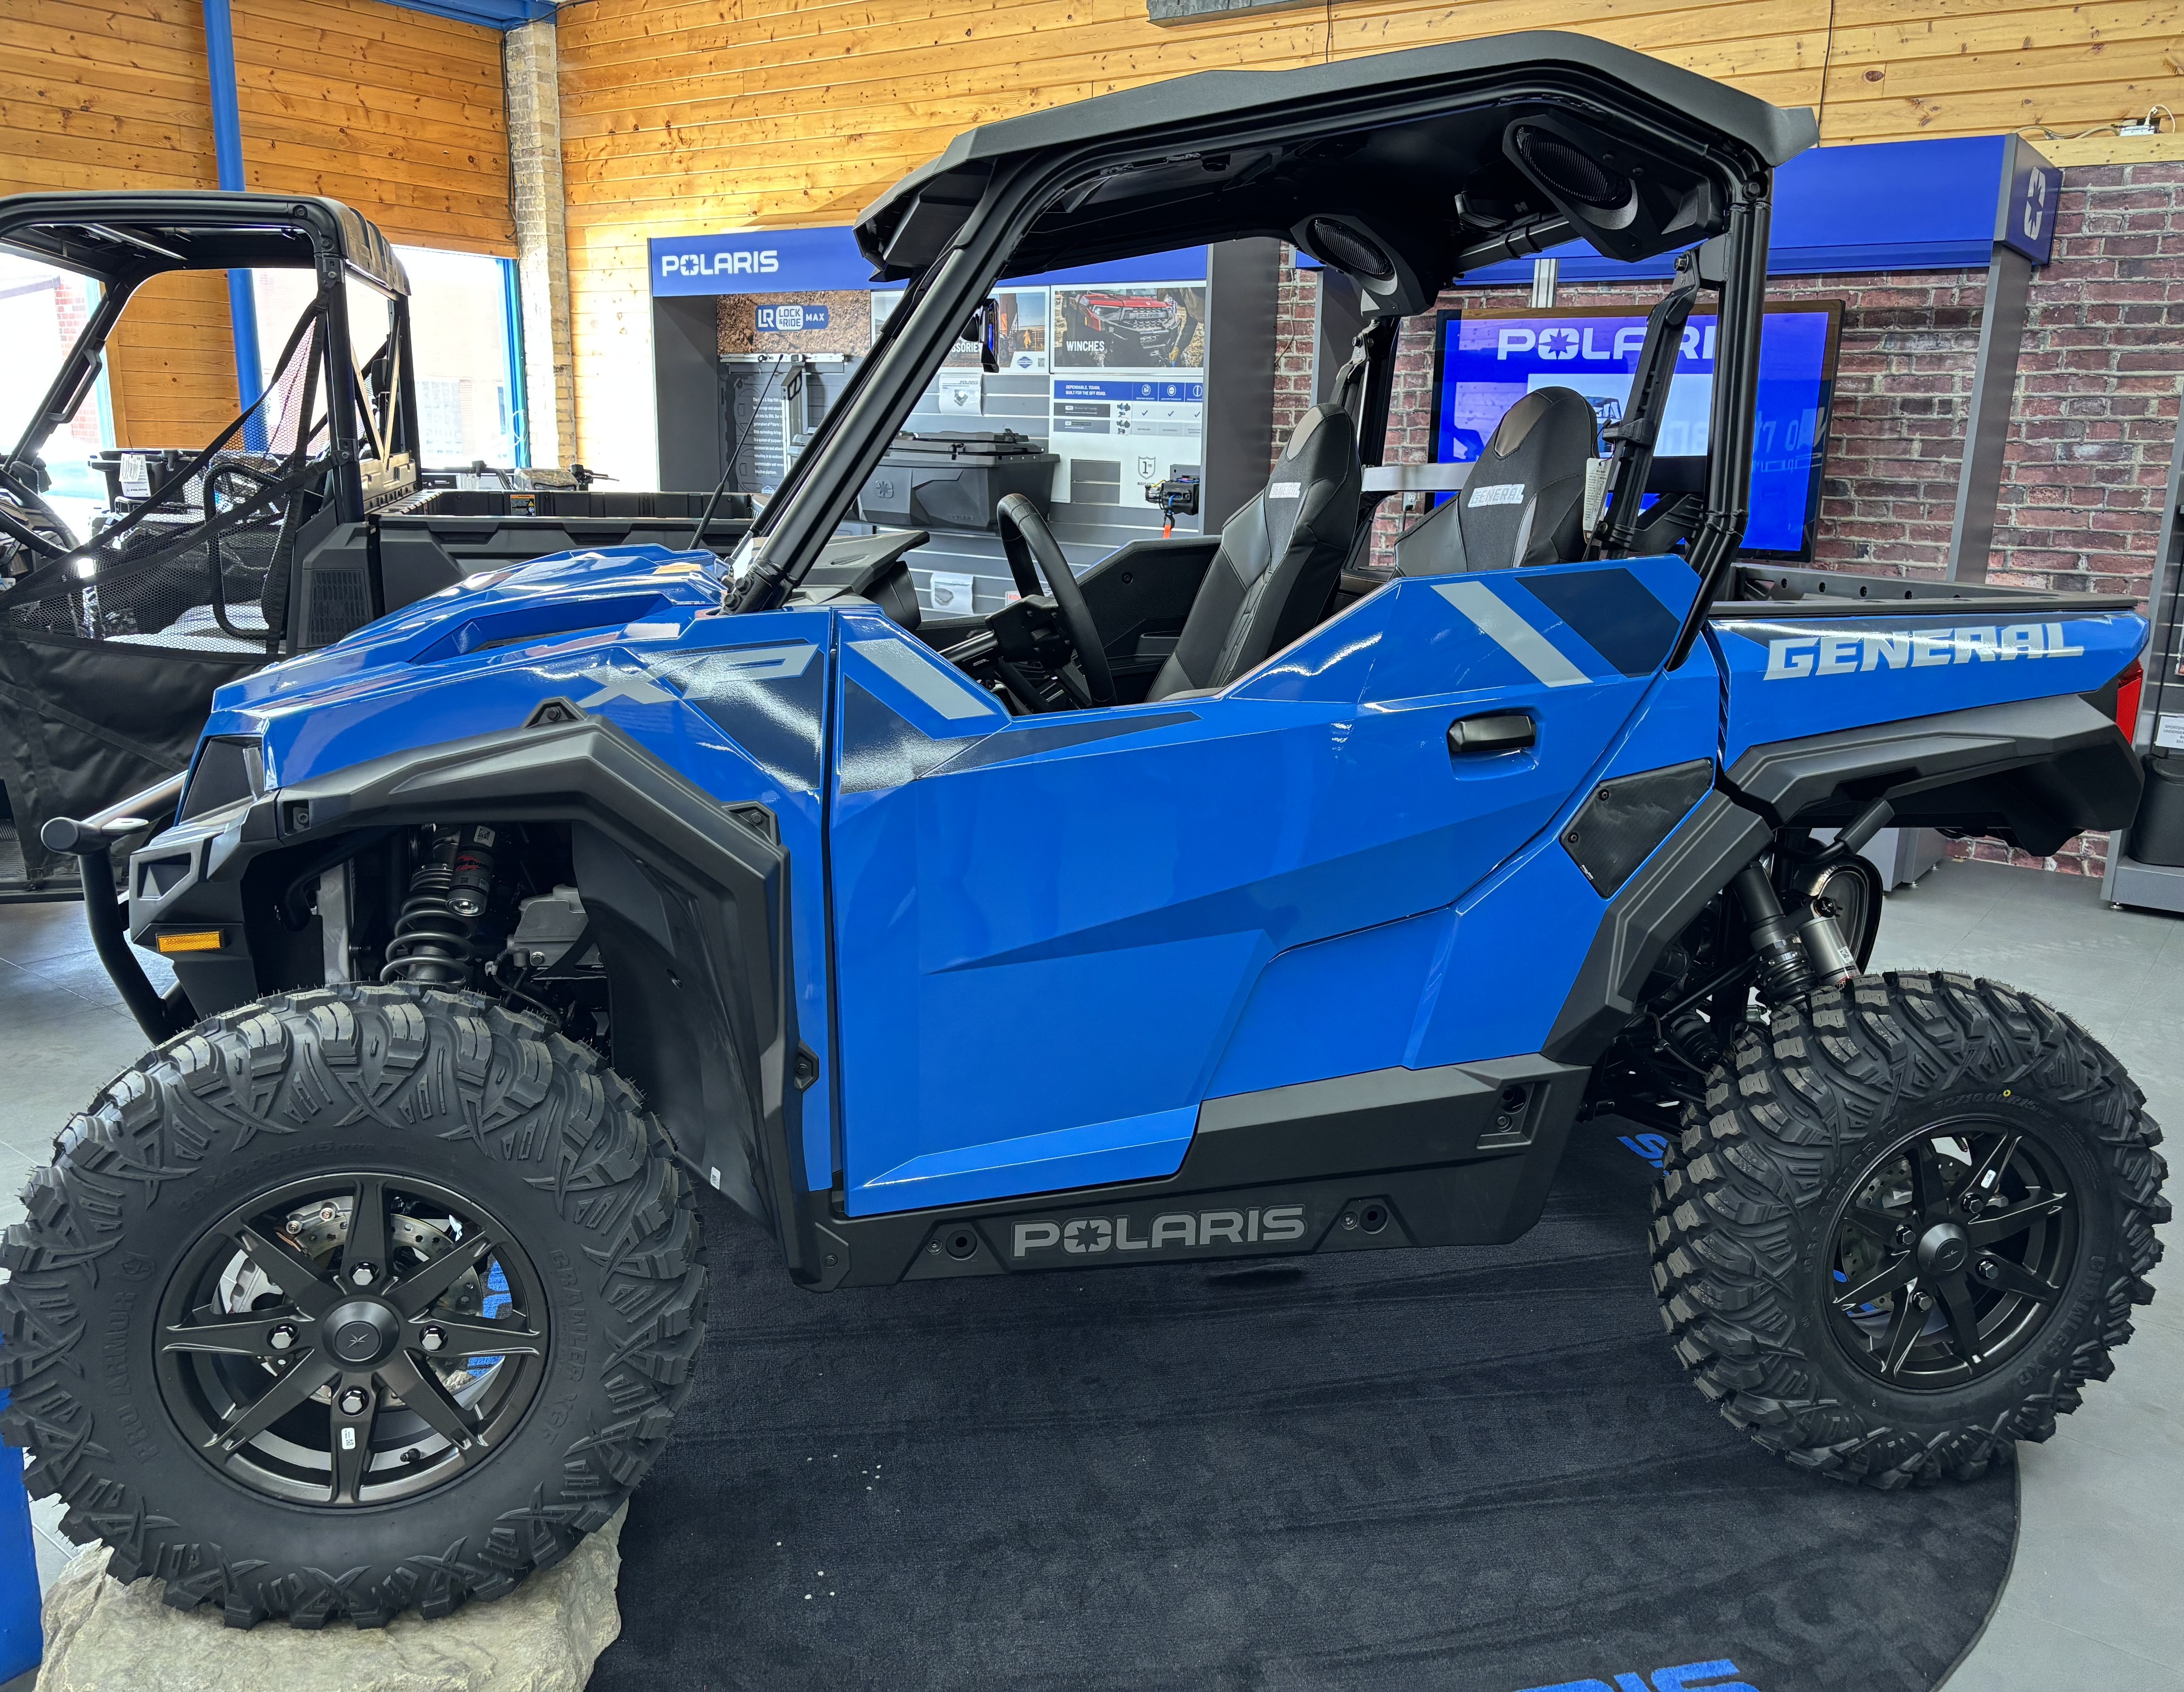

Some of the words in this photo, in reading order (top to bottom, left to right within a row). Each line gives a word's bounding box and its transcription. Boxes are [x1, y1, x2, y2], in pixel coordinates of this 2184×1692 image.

[661, 250, 779, 276] POLARIS
[779, 308, 800, 317] LOCK
[1066, 340, 1105, 352] WINCHES
[1497, 325, 1715, 360] POLARI
[1142, 461, 1148, 474] 1
[1469, 485, 1524, 506] GENERAL
[1763, 623, 2084, 681] GENERAL
[577, 643, 820, 708] XP
[1012, 1205, 1307, 1258] POLARIS
